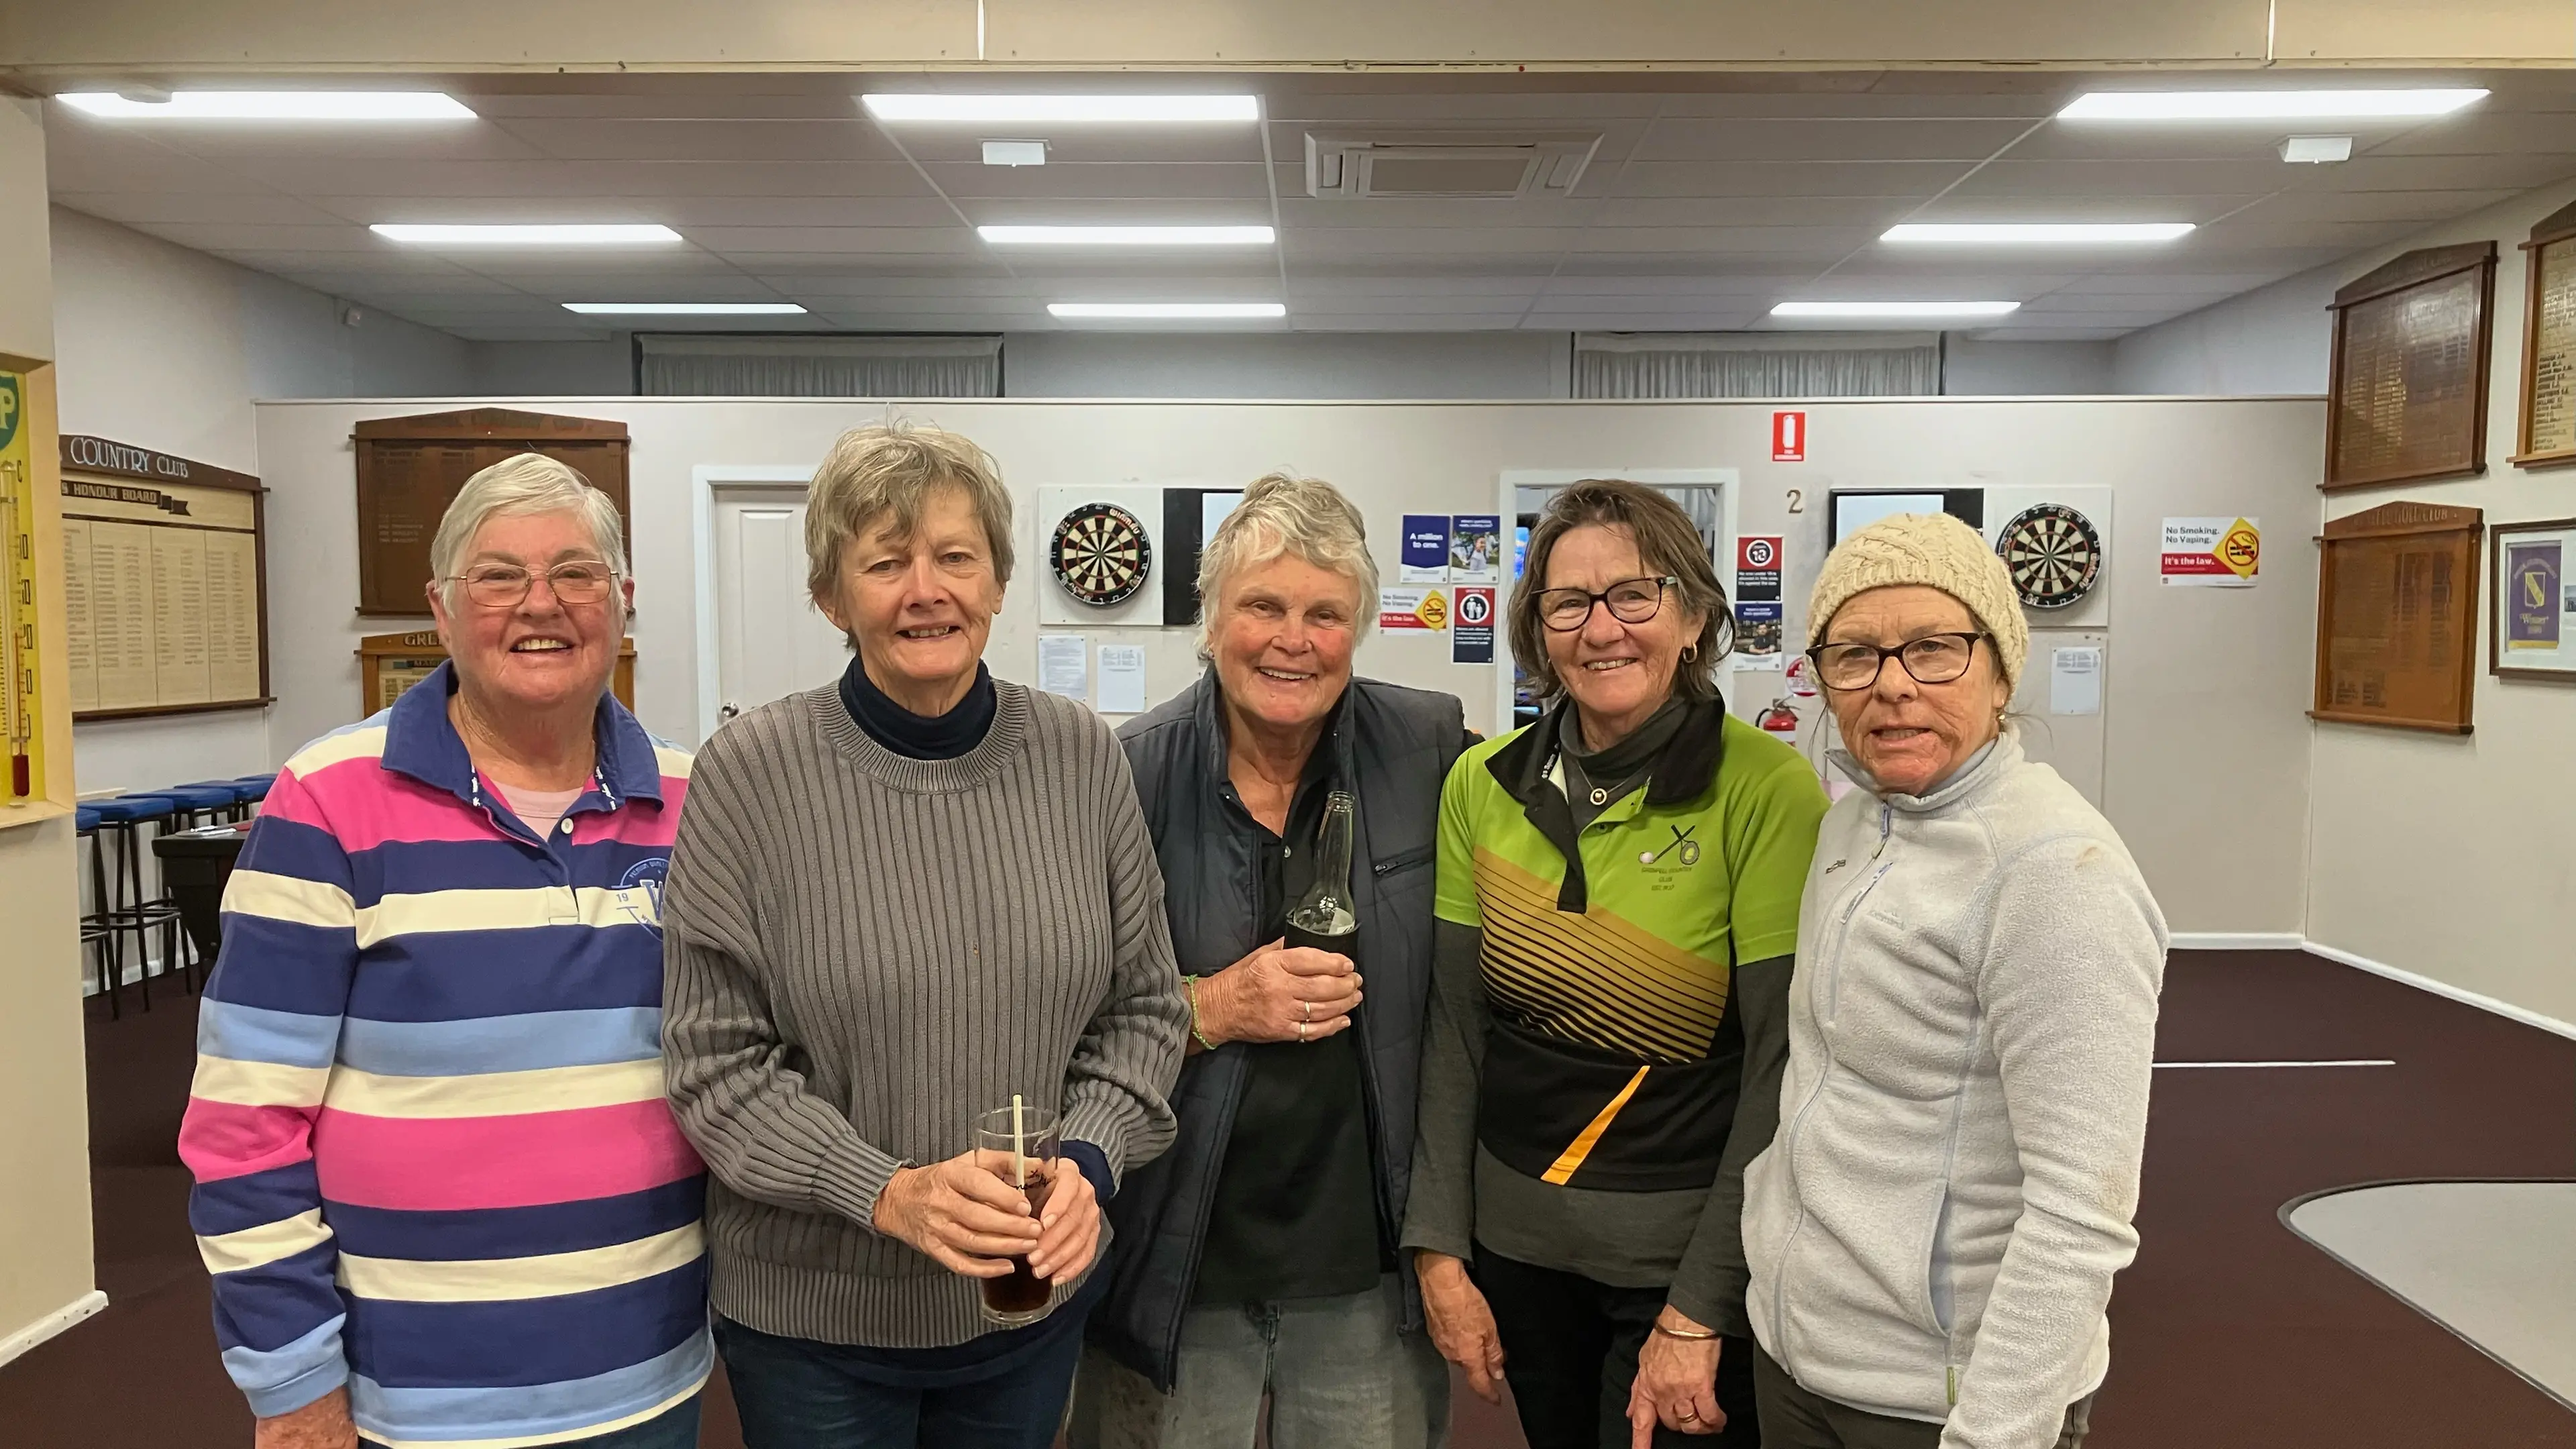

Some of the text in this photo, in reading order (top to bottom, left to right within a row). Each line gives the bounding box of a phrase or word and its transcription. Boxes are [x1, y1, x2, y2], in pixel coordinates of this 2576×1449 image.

[70, 437, 189, 478] COUNTRY CLUB
[74, 484, 118, 499] HONOUR
[121, 489, 157, 503] BOARD
[1786, 489, 1803, 514] 2
[2180, 526, 2220, 535] Smoking.
[2180, 536, 2212, 544] Vaping.
[2164, 556, 2215, 566] It's the law.
[616, 893, 629, 902] 19
